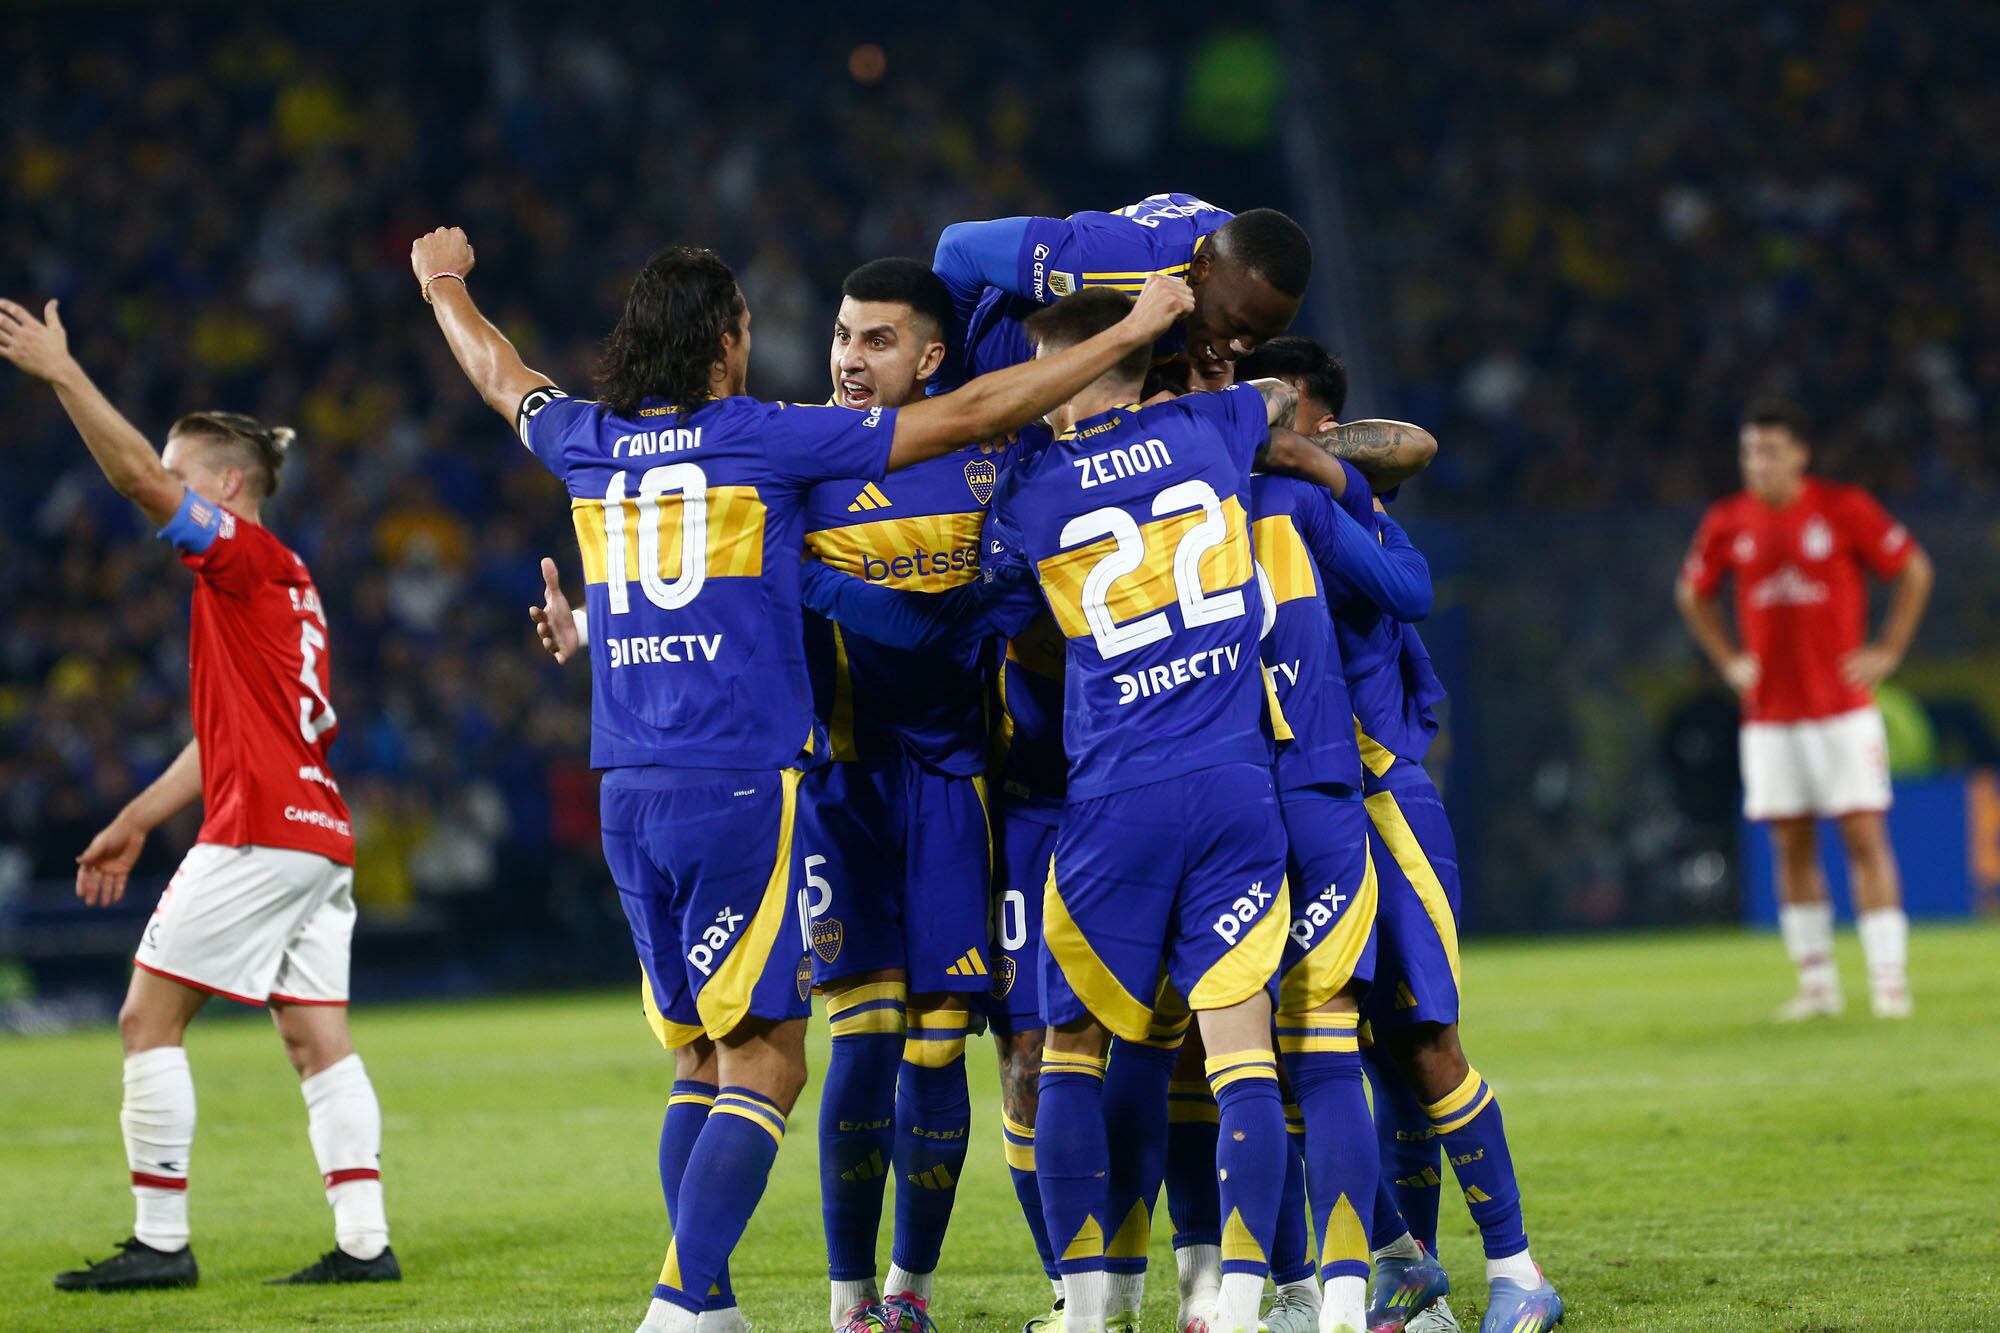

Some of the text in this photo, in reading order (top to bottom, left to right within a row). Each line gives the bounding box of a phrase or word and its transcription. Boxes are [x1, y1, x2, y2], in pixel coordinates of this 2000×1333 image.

[969, 474, 993, 485] CABJ
[1073, 439, 1172, 489] ZENON
[601, 462, 708, 615] 10
[862, 545, 977, 582] betsso
[1059, 480, 1246, 660] 22
[607, 634, 722, 668] DIRECTV
[1113, 643, 1241, 705] DIRECTV
[687, 906, 744, 976] pax
[1213, 881, 1272, 946] pax
[1289, 883, 1347, 950] pax
